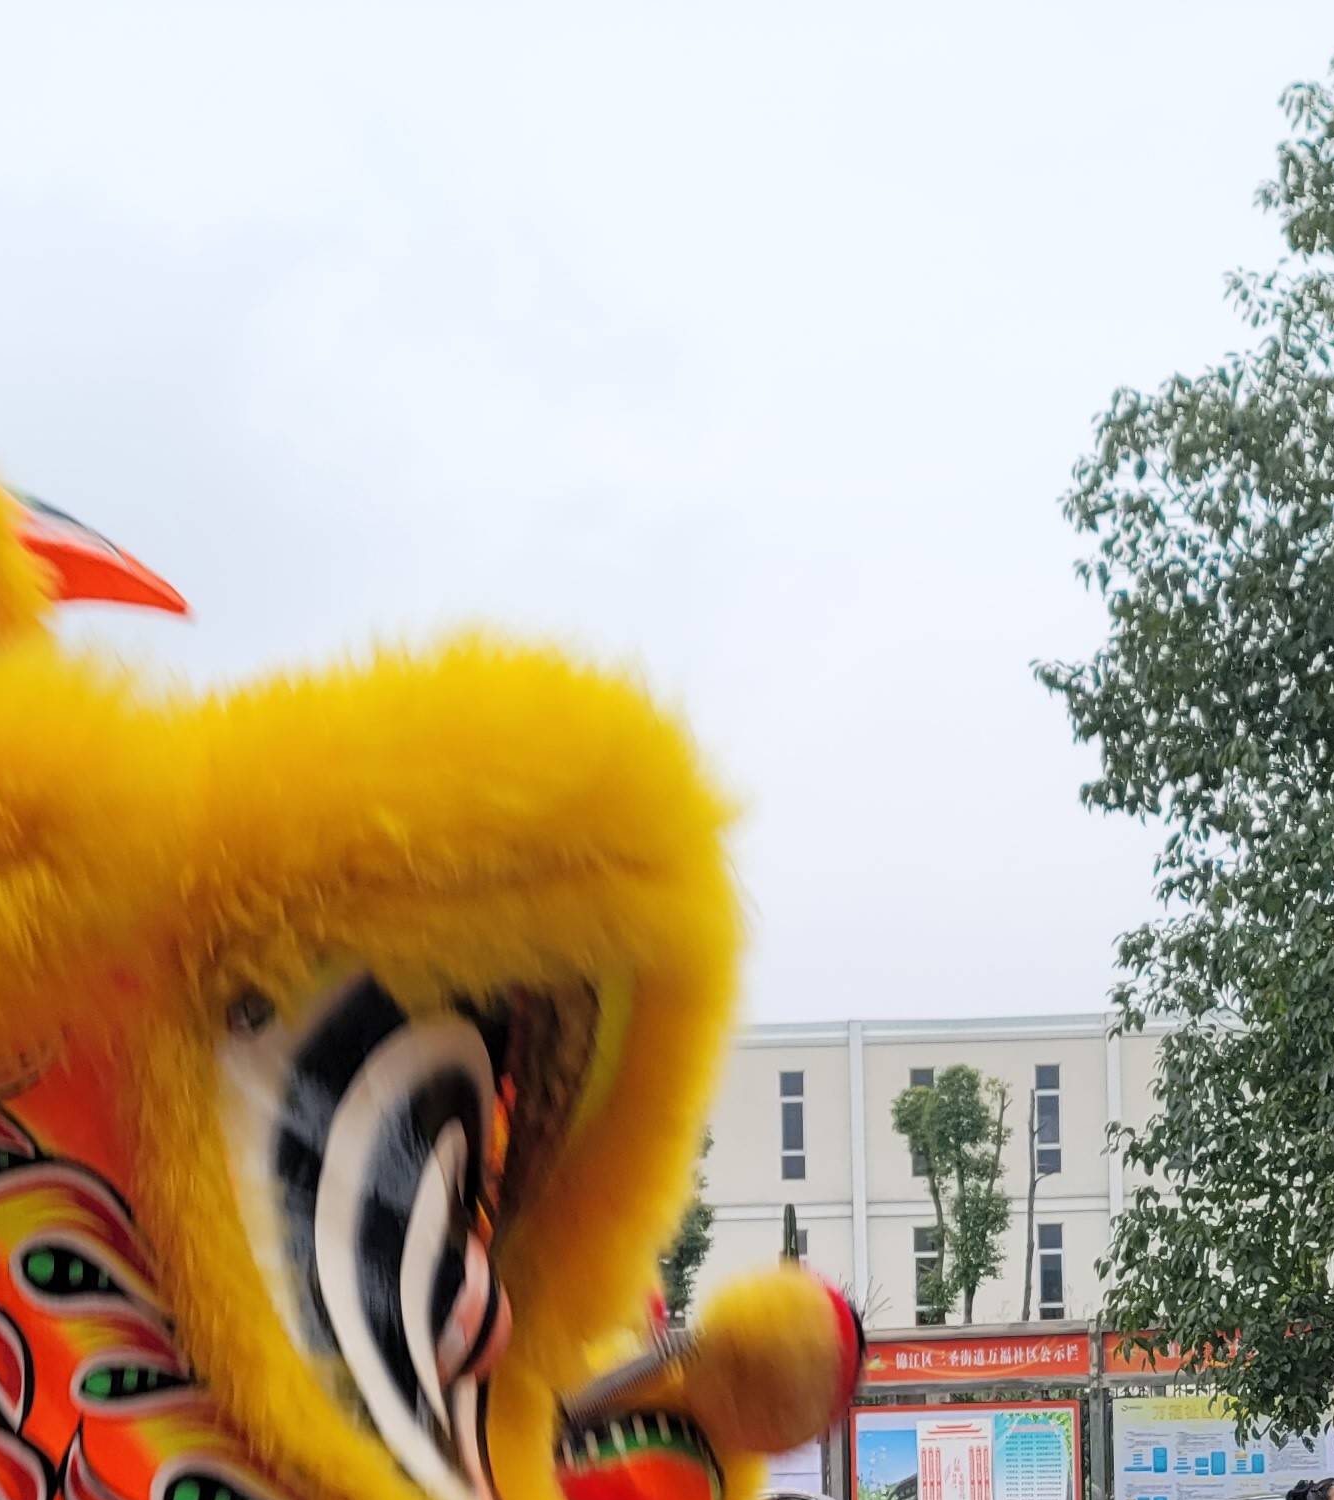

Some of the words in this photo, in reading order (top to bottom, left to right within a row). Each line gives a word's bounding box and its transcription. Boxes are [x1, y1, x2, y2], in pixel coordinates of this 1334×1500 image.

[895, 1344, 1079, 1370] 锦江区三圣街道万福社区公示栏
